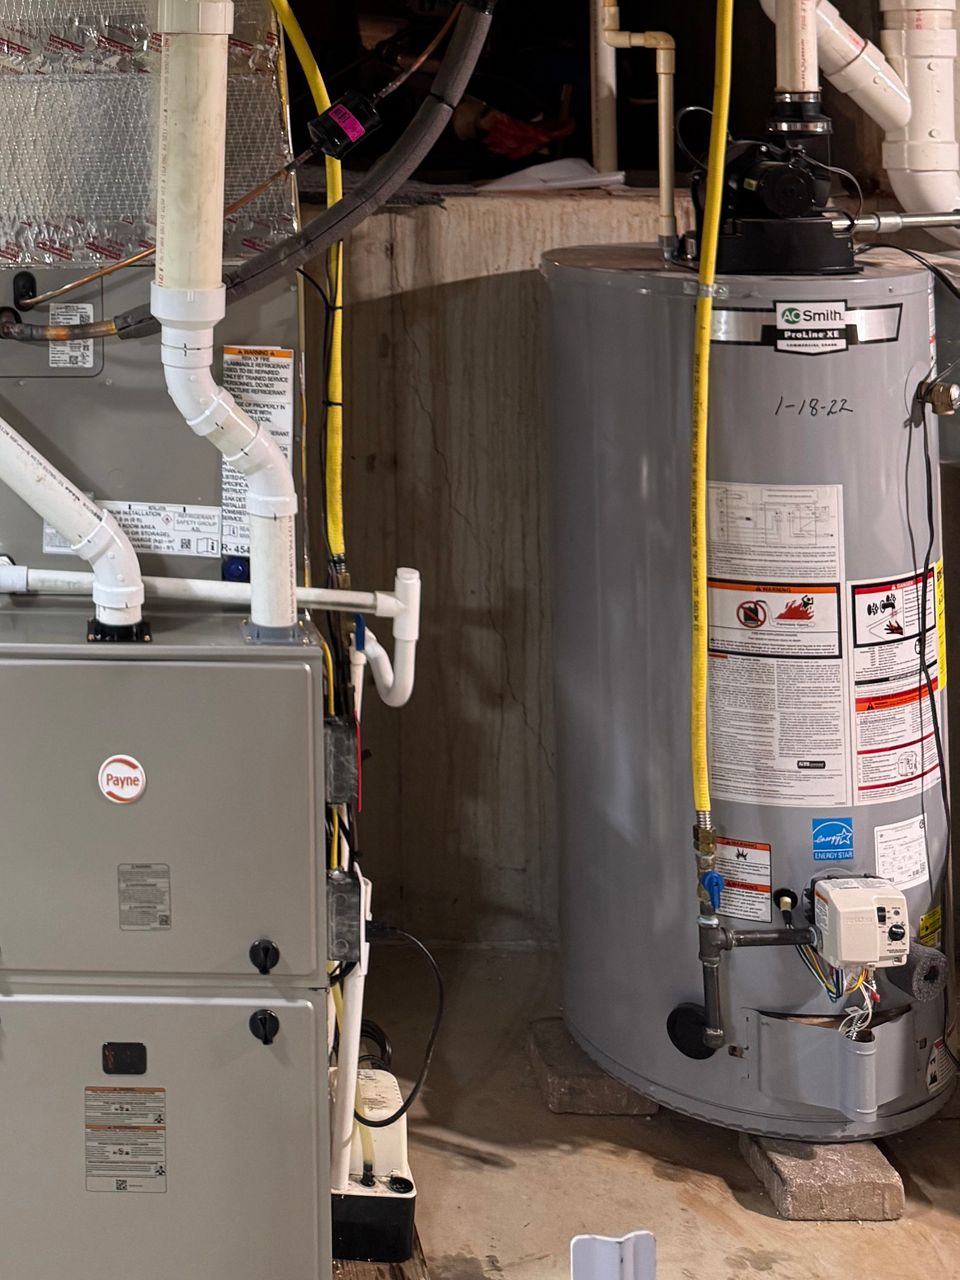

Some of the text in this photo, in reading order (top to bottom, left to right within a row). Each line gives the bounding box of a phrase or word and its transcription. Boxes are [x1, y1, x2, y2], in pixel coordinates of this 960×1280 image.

[802, 309, 842, 322] Smith
[784, 330, 840, 339] ProLine XE
[775, 395, 854, 417] 1-18-22
[106, 773, 140, 789] Payne
[838, 851, 853, 859] STAR
